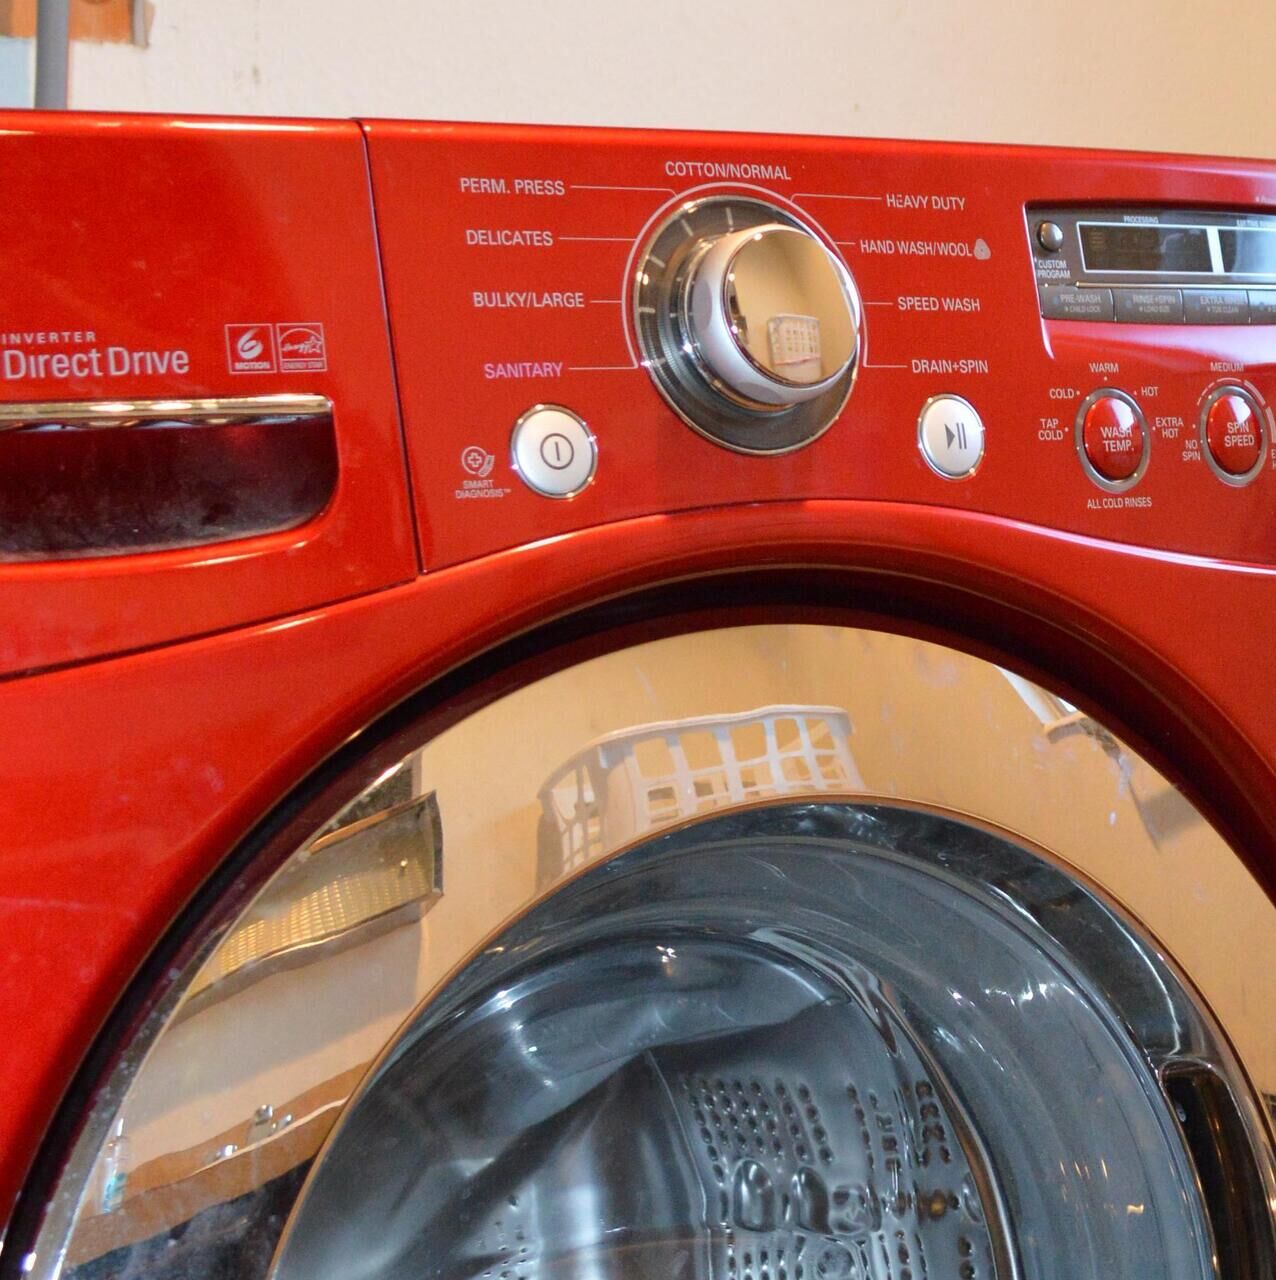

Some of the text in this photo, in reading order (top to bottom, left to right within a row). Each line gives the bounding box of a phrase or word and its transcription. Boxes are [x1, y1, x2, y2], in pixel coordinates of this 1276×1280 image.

[665, 161, 791, 180] COTTON/NORMAL
[460, 177, 565, 196] PERM. PRESS
[886, 193, 965, 210] HEAVY DUTY
[466, 230, 553, 246] DELICATES
[860, 239, 973, 257] HAND WASH/WOOL
[1038, 259, 1066, 269] CUSTOM
[1037, 269, 1071, 279] PROGRAM
[472, 292, 585, 308] BULKY/LARGE
[898, 296, 980, 312] SPEED WASH
[1060, 294, 1102, 303] PRE-WASH
[1, 331, 96, 345] INVERTER
[3, 347, 190, 379] Direct Drive
[911, 359, 988, 374] DRAIN+SPIN
[1089, 363, 1119, 372] WARM
[1210, 361, 1245, 372] MEDIUM
[483, 362, 564, 379] SANITARY
[1049, 388, 1075, 399] COLD
[1141, 386, 1159, 397] HOT
[1040, 418, 1059, 428] TAP
[1155, 417, 1184, 427] EXTRA
[1226, 421, 1249, 433] SPIN
[1038, 430, 1063, 440] COLD
[1100, 426, 1133, 438] WASH
[1162, 427, 1179, 438] HOT
[1103, 439, 1134, 452] TEMP.
[1185, 439, 1198, 450] NO
[1224, 434, 1255, 447] SPEED
[1182, 451, 1200, 461] SPIN
[463, 480, 493, 489] SMART
[1087, 496, 1152, 509] ALL COLD RINSES
